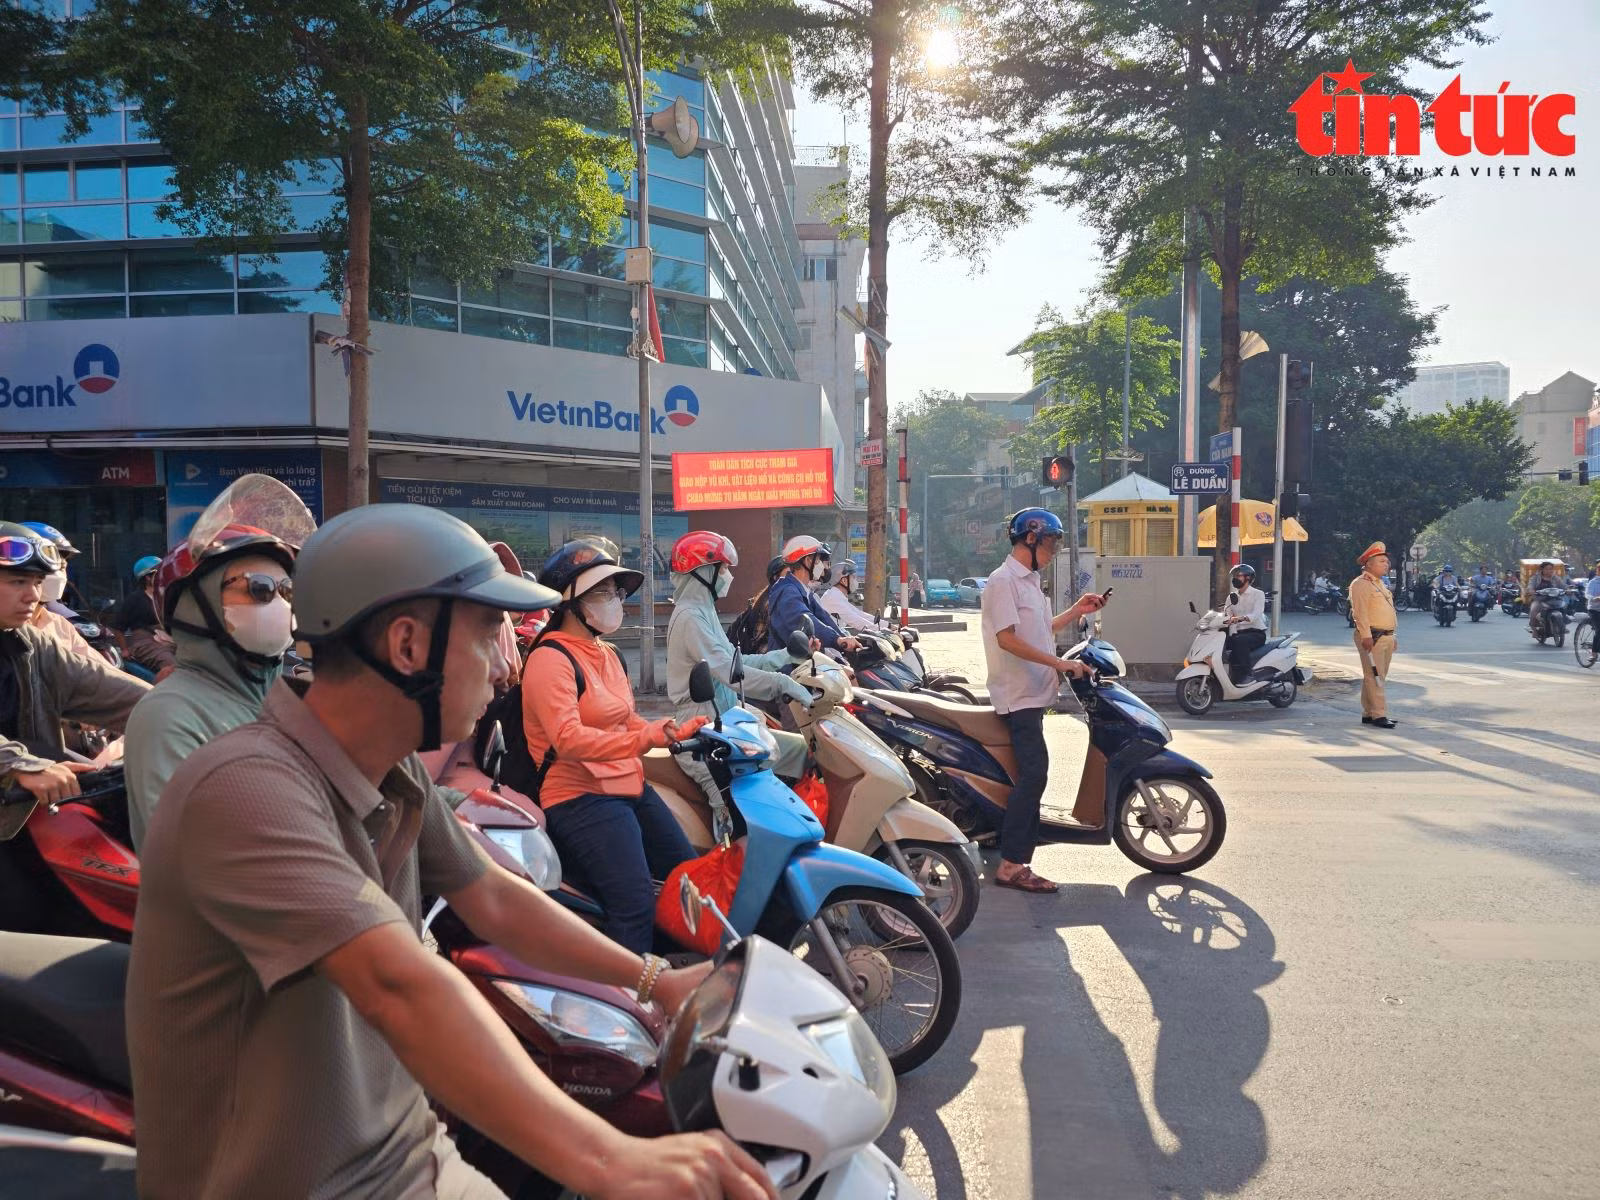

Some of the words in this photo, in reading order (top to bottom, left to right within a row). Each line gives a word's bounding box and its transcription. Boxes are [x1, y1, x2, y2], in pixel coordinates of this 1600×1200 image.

[101, 467, 129, 480] ATM
[1189, 467, 1215, 475] ĐƯỜNG
[1174, 476, 1188, 489] LÊ
[1192, 474, 1226, 489] DUẨN
[492, 489, 510, 498] CHO
[512, 490, 526, 499] VAY
[553, 496, 570, 505] CHO
[571, 497, 585, 505] VAY
[887, 718, 933, 739] VISION
[563, 1082, 613, 1096] HONDA
